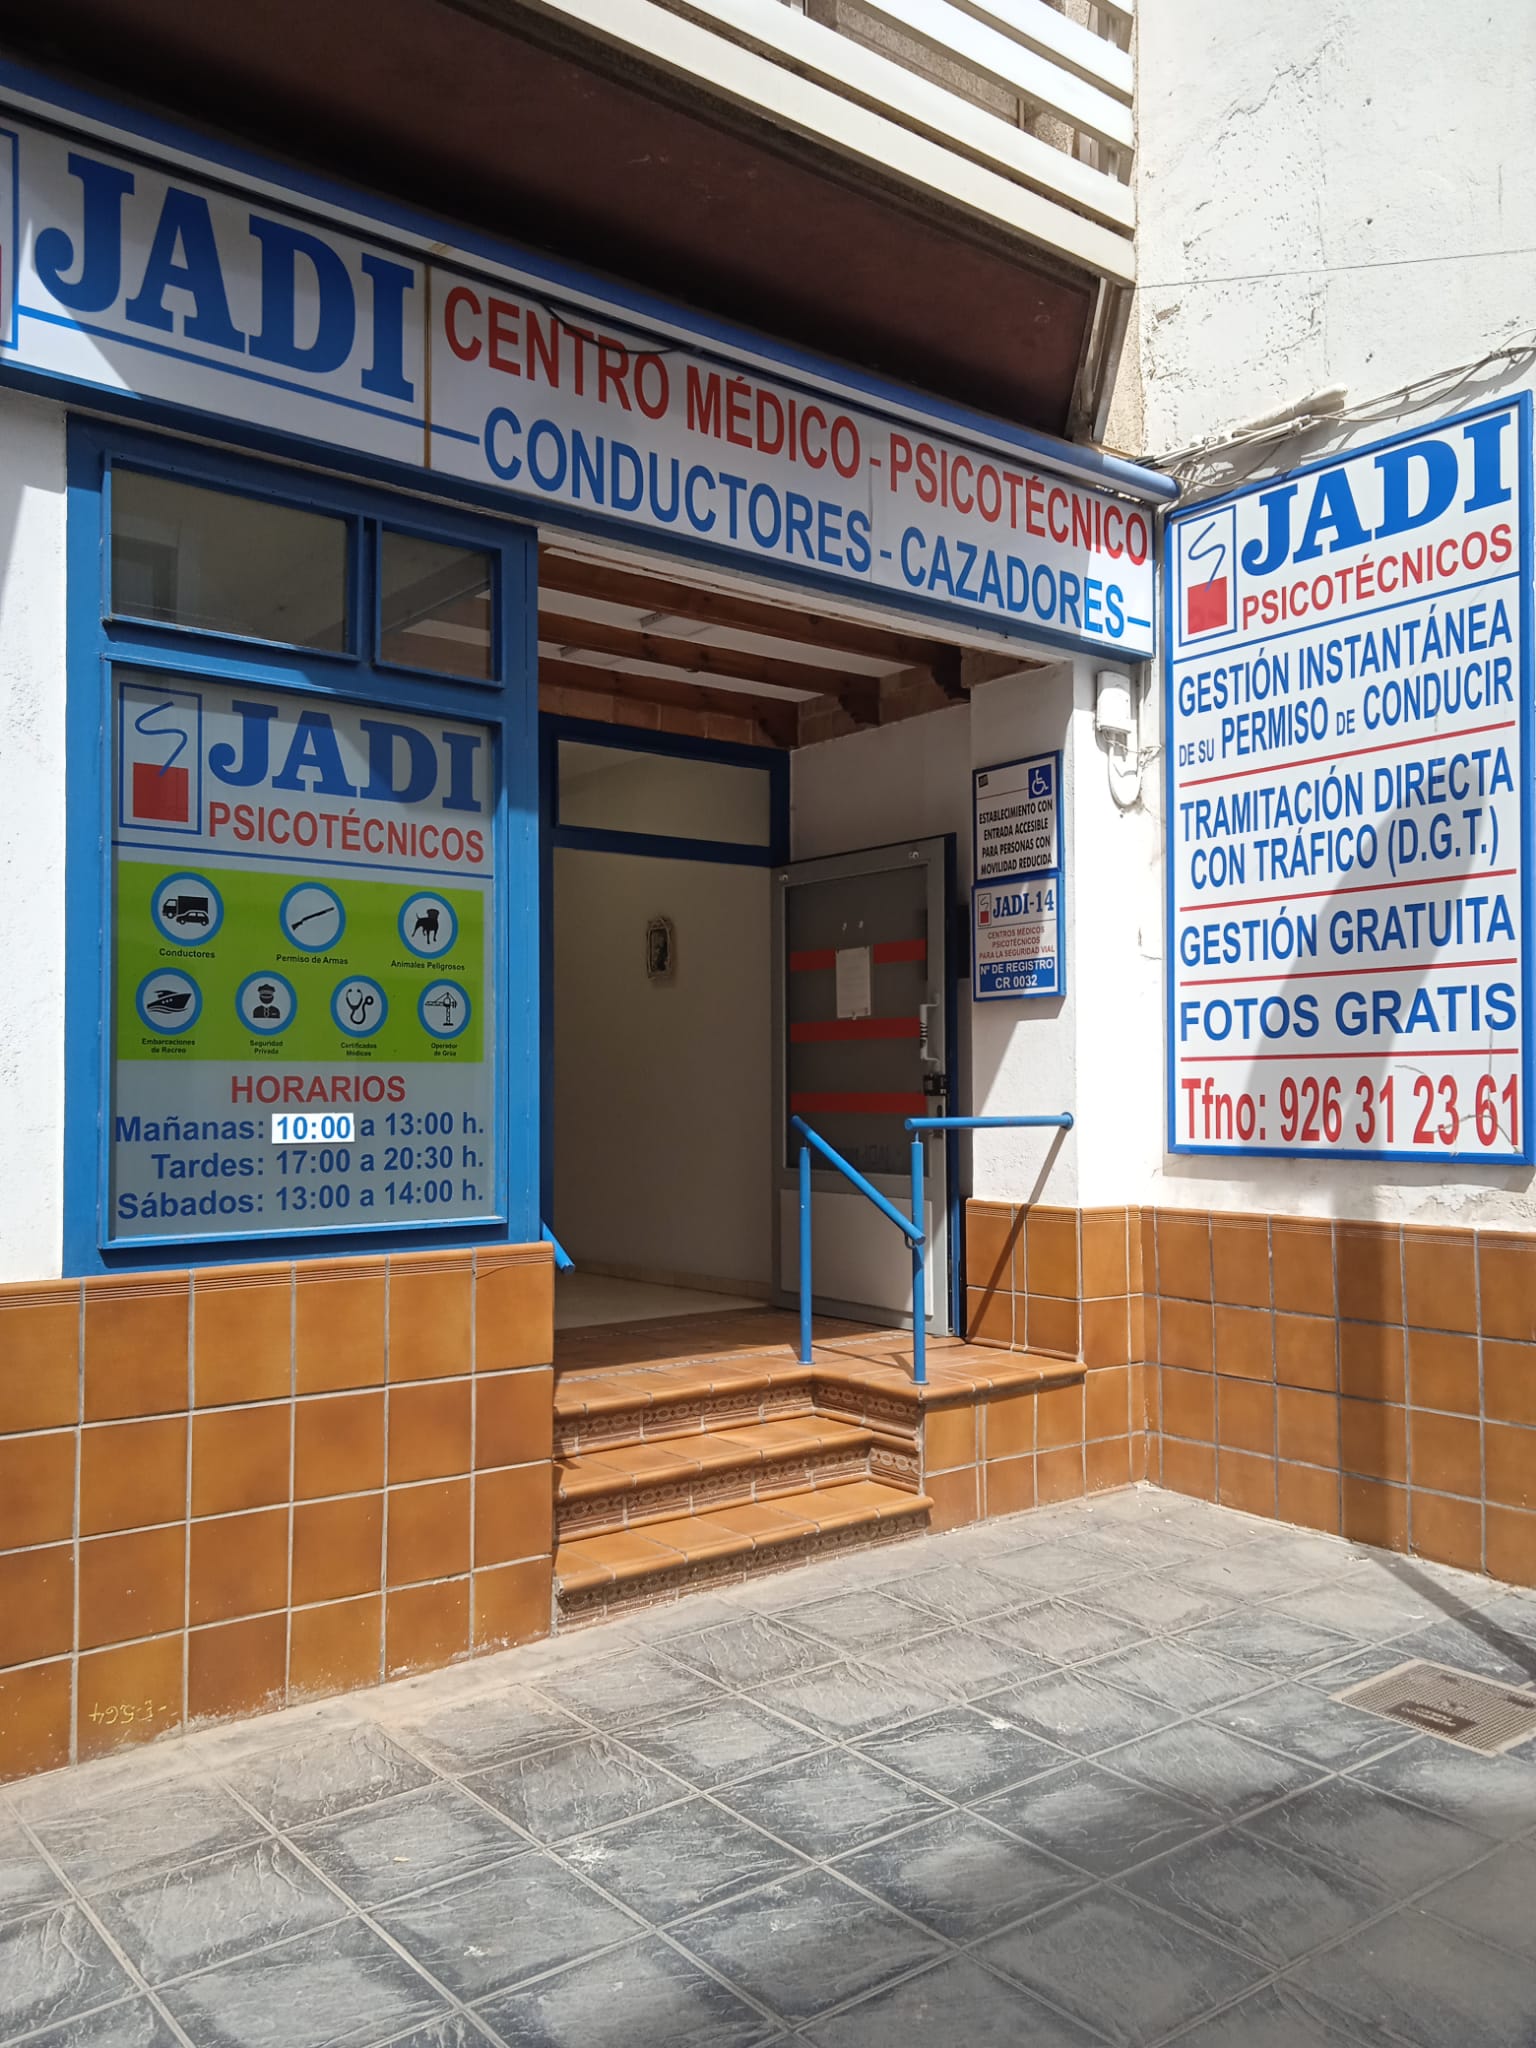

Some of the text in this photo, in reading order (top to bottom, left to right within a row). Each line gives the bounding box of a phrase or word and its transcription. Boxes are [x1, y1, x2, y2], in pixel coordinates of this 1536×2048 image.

[35, 152, 414, 402] JADI
[444, 286, 670, 420] CENTRO
[686, 364, 861, 479] MÉDICO
[890, 432, 1148, 566] PSICOTÉCNICO
[1240, 412, 1511, 577] JADI
[483, 406, 871, 573] CONDUCTORES
[900, 526, 1125, 638] CAZADORES
[1243, 523, 1512, 630] PSICOTÉCNICOS
[1179, 598, 1512, 717] GESTIÓN INSTANTÁNEA
[1179, 655, 1514, 767] DE SU PERMISO DE CONDUCIR
[208, 700, 481, 813] JADI
[1180, 746, 1515, 842] TRAMITACIÓN DIRECTA
[979, 799, 1053, 824] ESTABLECIMIENTO CON
[209, 802, 484, 864] PSICOTÉCNICOS
[984, 817, 1048, 841] ENTRADA ACCESIBLE
[982, 835, 1051, 858] PARA PERSONAS CON
[1191, 805, 1499, 890] CON TRÁFICO (D.G.T.)
[981, 853, 1052, 875] MOVILIDAD REDUCIDA
[993, 889, 1054, 918] JADI-14
[987, 929, 1015, 940] CENTROS
[1180, 894, 1516, 967] GESTIÓN GRATUITA
[159, 948, 216, 959] Conductores
[276, 953, 348, 965] Permiso de Armas
[391, 960, 465, 971] Animales Peligrosos
[979, 945, 1055, 959] PARA LA SEGURIDAD VIAL
[992, 963, 1004, 974] DE
[1006, 959, 1054, 972] REGISTRO
[995, 974, 1038, 989] CR 0032
[1181, 982, 1517, 1042] FOTOS GRATIS
[142, 1038, 195, 1046] Embarcaciones
[250, 1040, 283, 1048] Seguridad
[230, 1074, 406, 1104] HORARIOS
[1181, 1073, 1518, 1146] Tfno: 926 31 23 61
[115, 1111, 484, 1142] Mañanas: 10:00 a 13:00 h.
[152, 1145, 484, 1180] Tardes: 17:00 a 20:30 h.
[118, 1179, 484, 1220] Sábados: 13:00 a 14:00 h.
